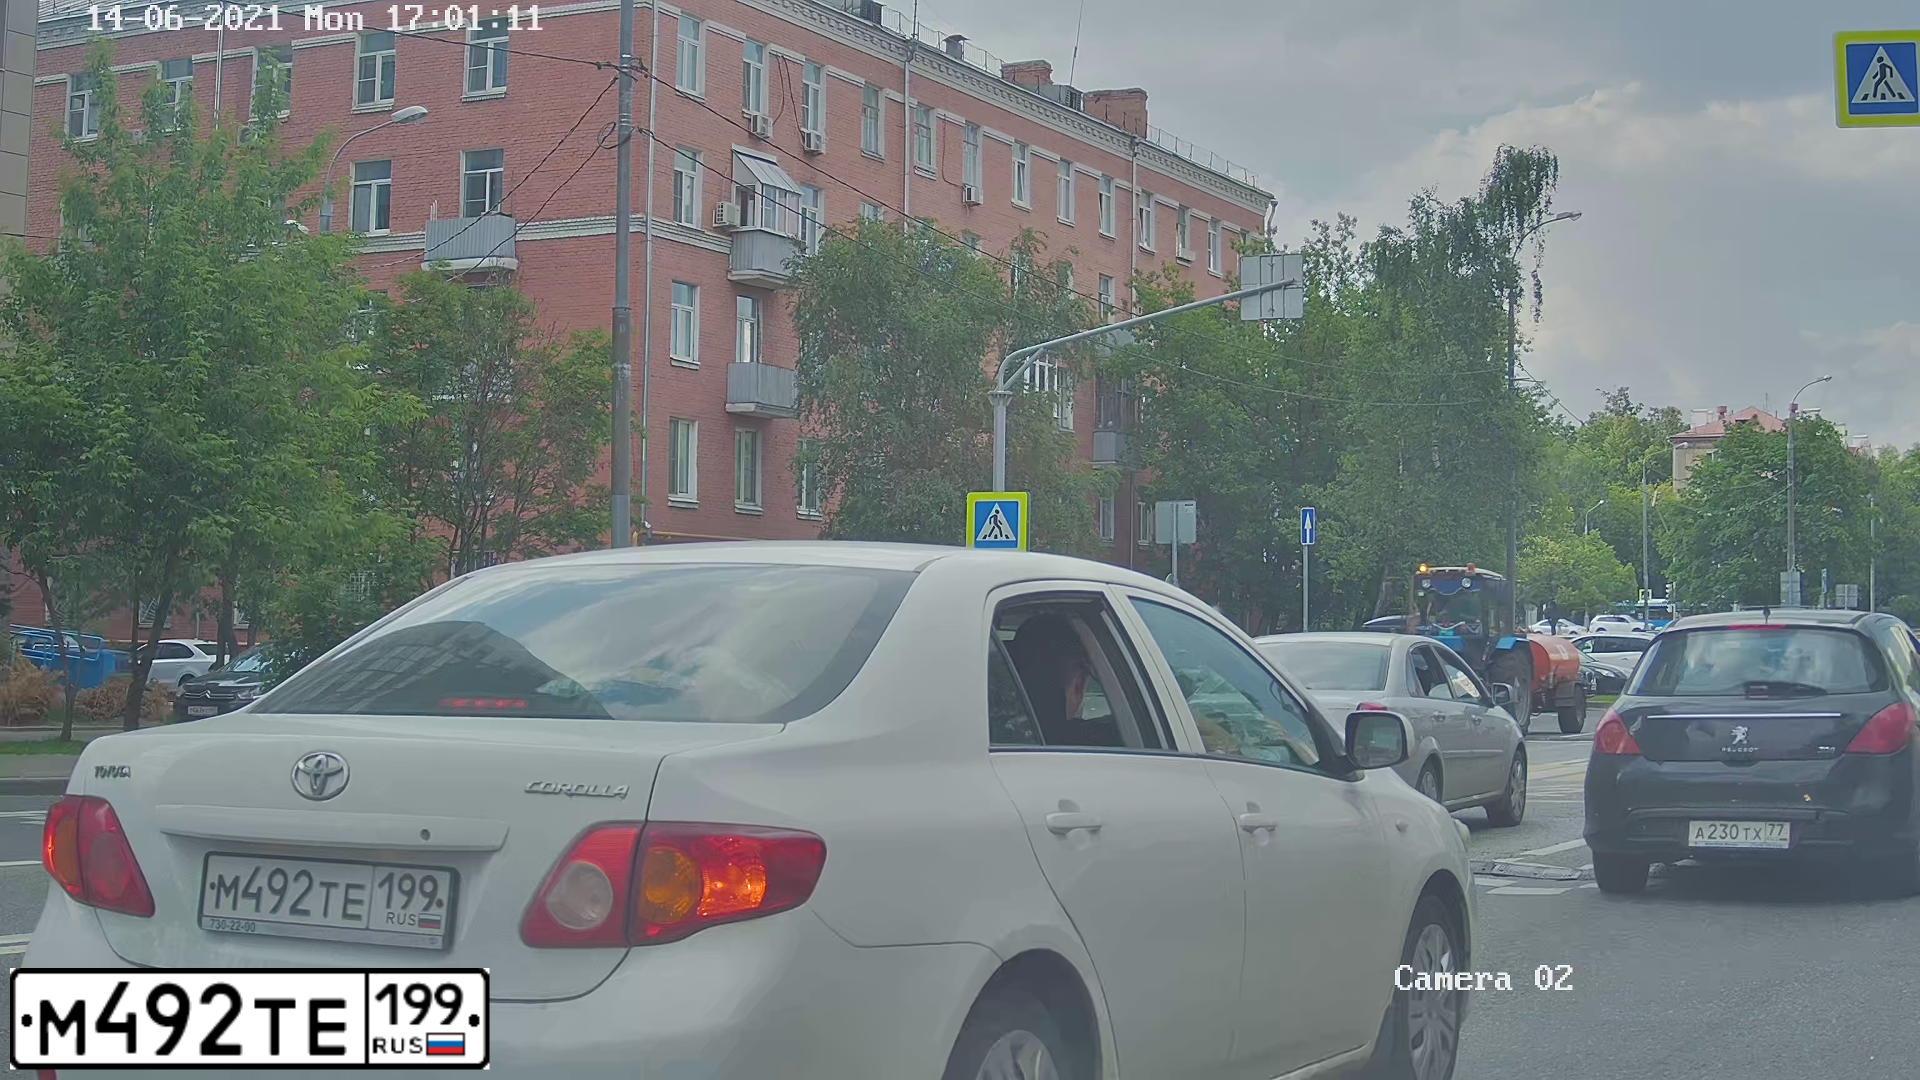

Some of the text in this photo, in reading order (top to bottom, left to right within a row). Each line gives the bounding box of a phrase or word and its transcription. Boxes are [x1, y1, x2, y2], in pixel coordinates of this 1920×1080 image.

[524, 781, 630, 800] COROLLA
[1768, 823, 1784, 836] 77
[377, 872, 439, 912] 199
[210, 918, 256, 933] 730-22-00
[385, 911, 416, 926] RUS
